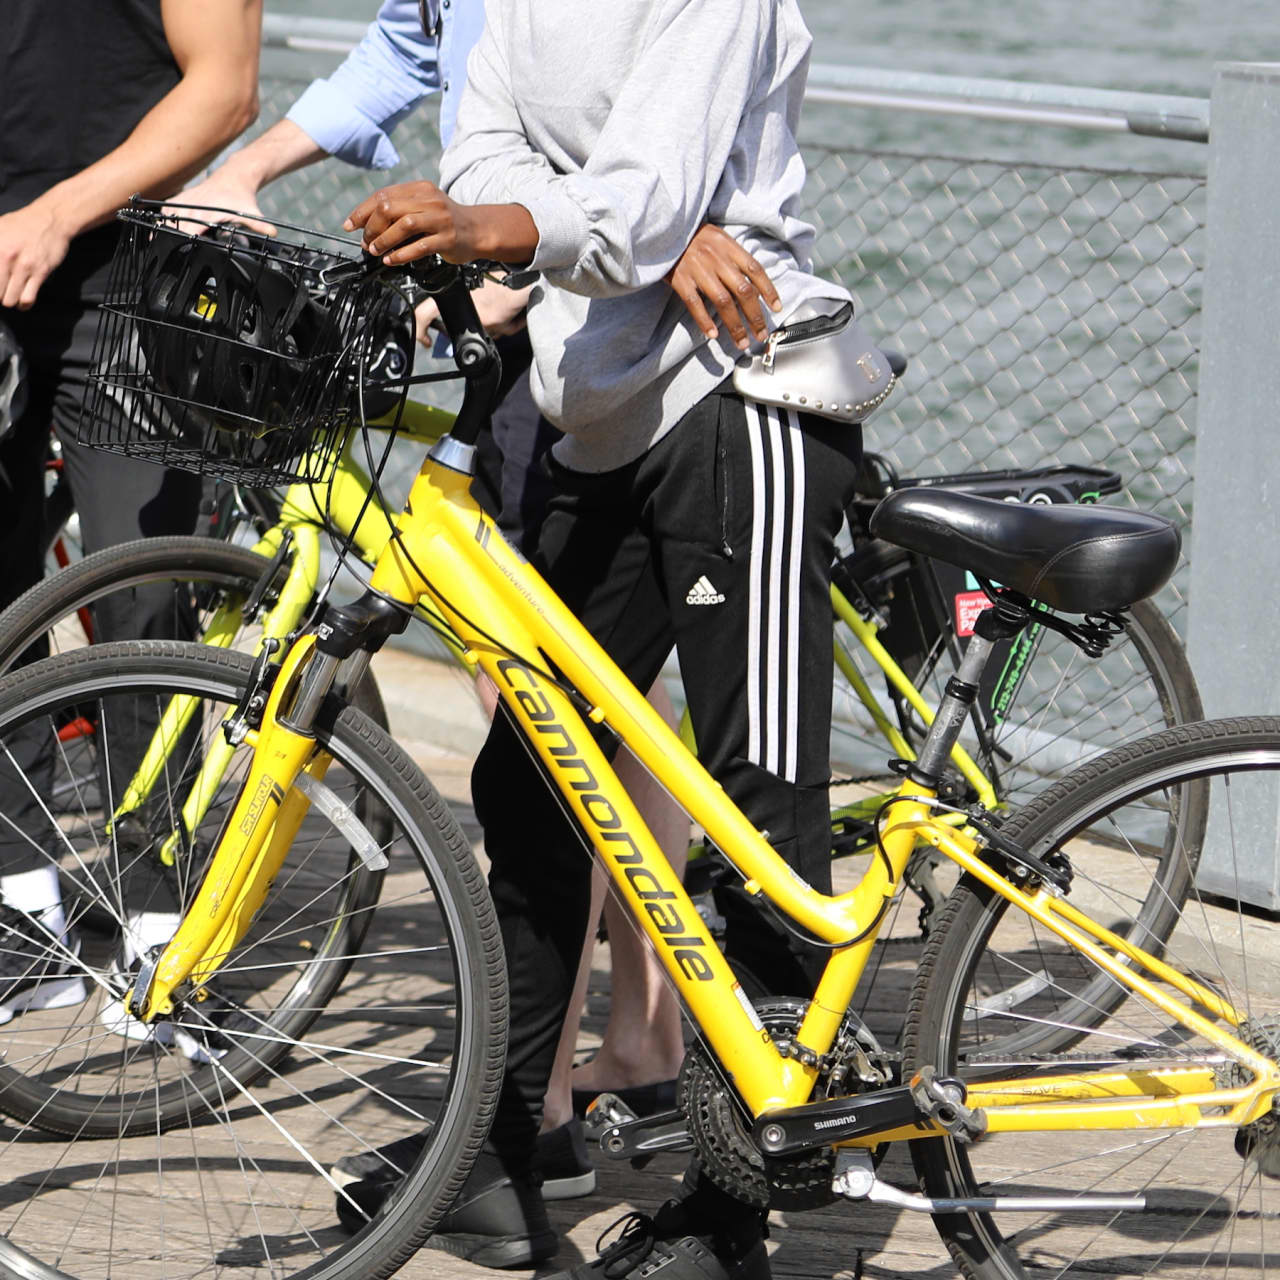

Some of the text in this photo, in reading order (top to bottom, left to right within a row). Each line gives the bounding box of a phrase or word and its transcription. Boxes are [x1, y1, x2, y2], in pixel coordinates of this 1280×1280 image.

[685, 593, 726, 605] adidas
[496, 658, 715, 982] cannondale
[813, 1114, 857, 1131] SHIMANO
